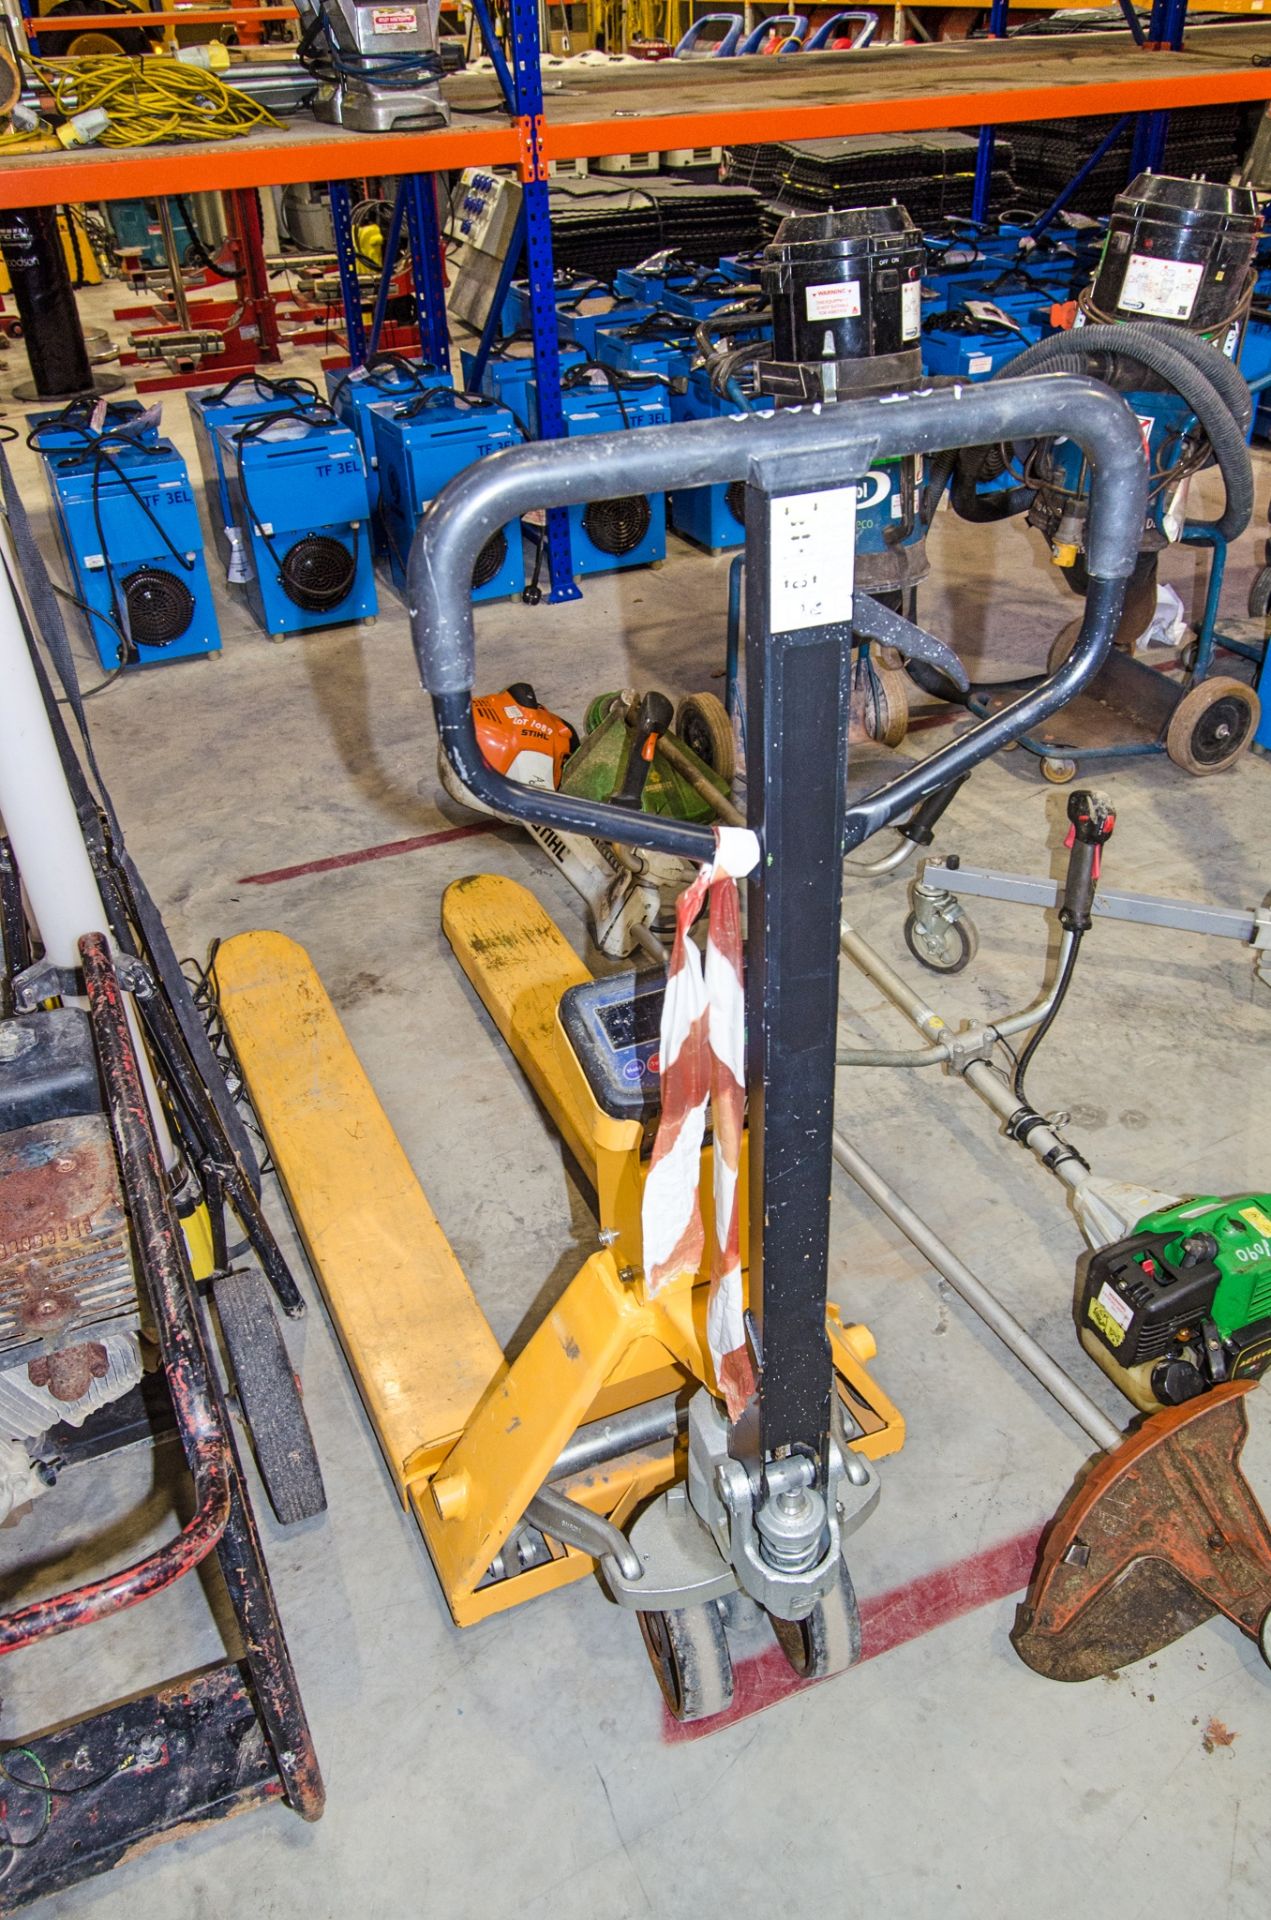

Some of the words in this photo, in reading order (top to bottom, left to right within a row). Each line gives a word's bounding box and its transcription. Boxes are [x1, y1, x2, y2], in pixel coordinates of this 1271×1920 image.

[8, 256, 40, 267] oodson
[879, 258, 889, 266] OFF
[629, 415, 645, 427] TF
[648, 412, 667, 425] 3EL
[476, 443, 493, 457] TF
[315, 464, 332, 477] TF
[337, 460, 361, 475] 3EL
[143, 493, 160, 508] TF
[166, 490, 192, 505] 3EL
[512, 717, 529, 725] LOT
[530, 719, 554, 736] 1089
[520, 728, 549, 741] STIHL
